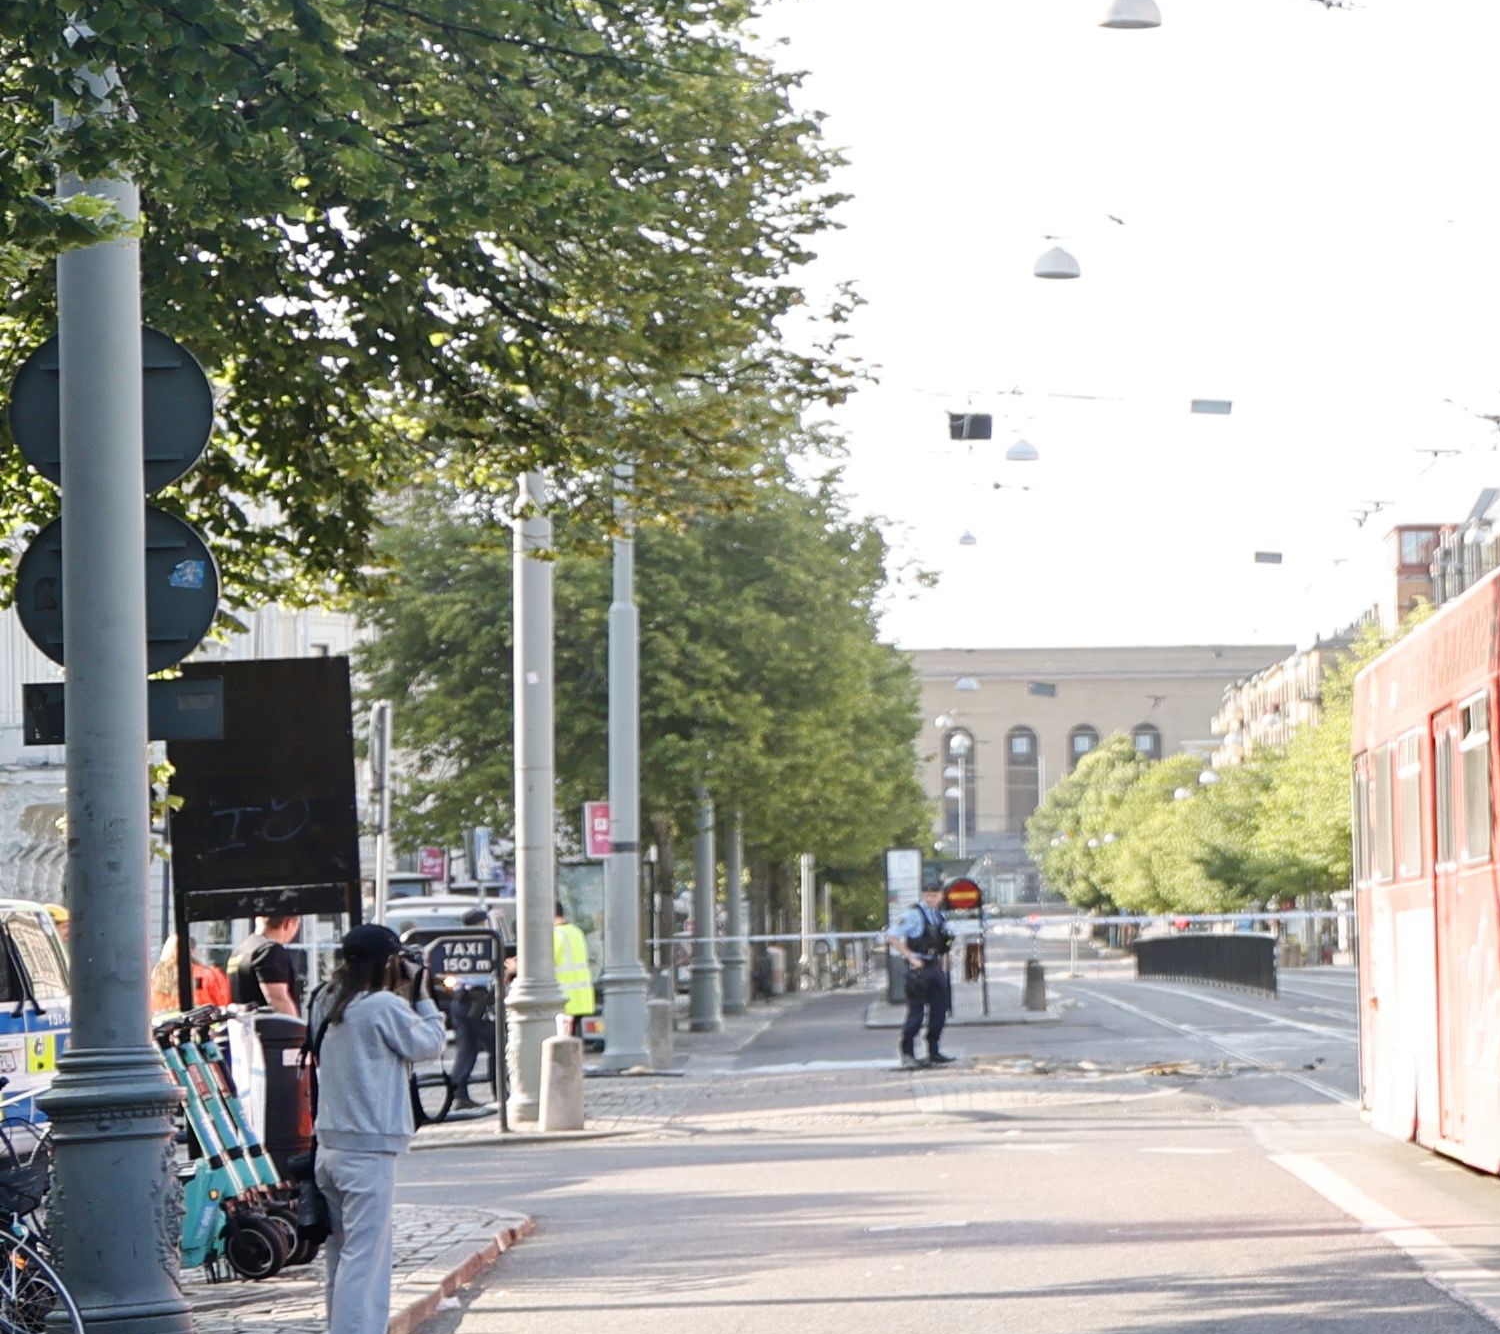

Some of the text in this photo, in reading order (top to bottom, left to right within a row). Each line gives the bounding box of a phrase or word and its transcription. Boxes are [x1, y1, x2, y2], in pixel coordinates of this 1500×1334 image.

[442, 942, 484, 955] TAXI
[442, 958, 492, 972] 150 m
